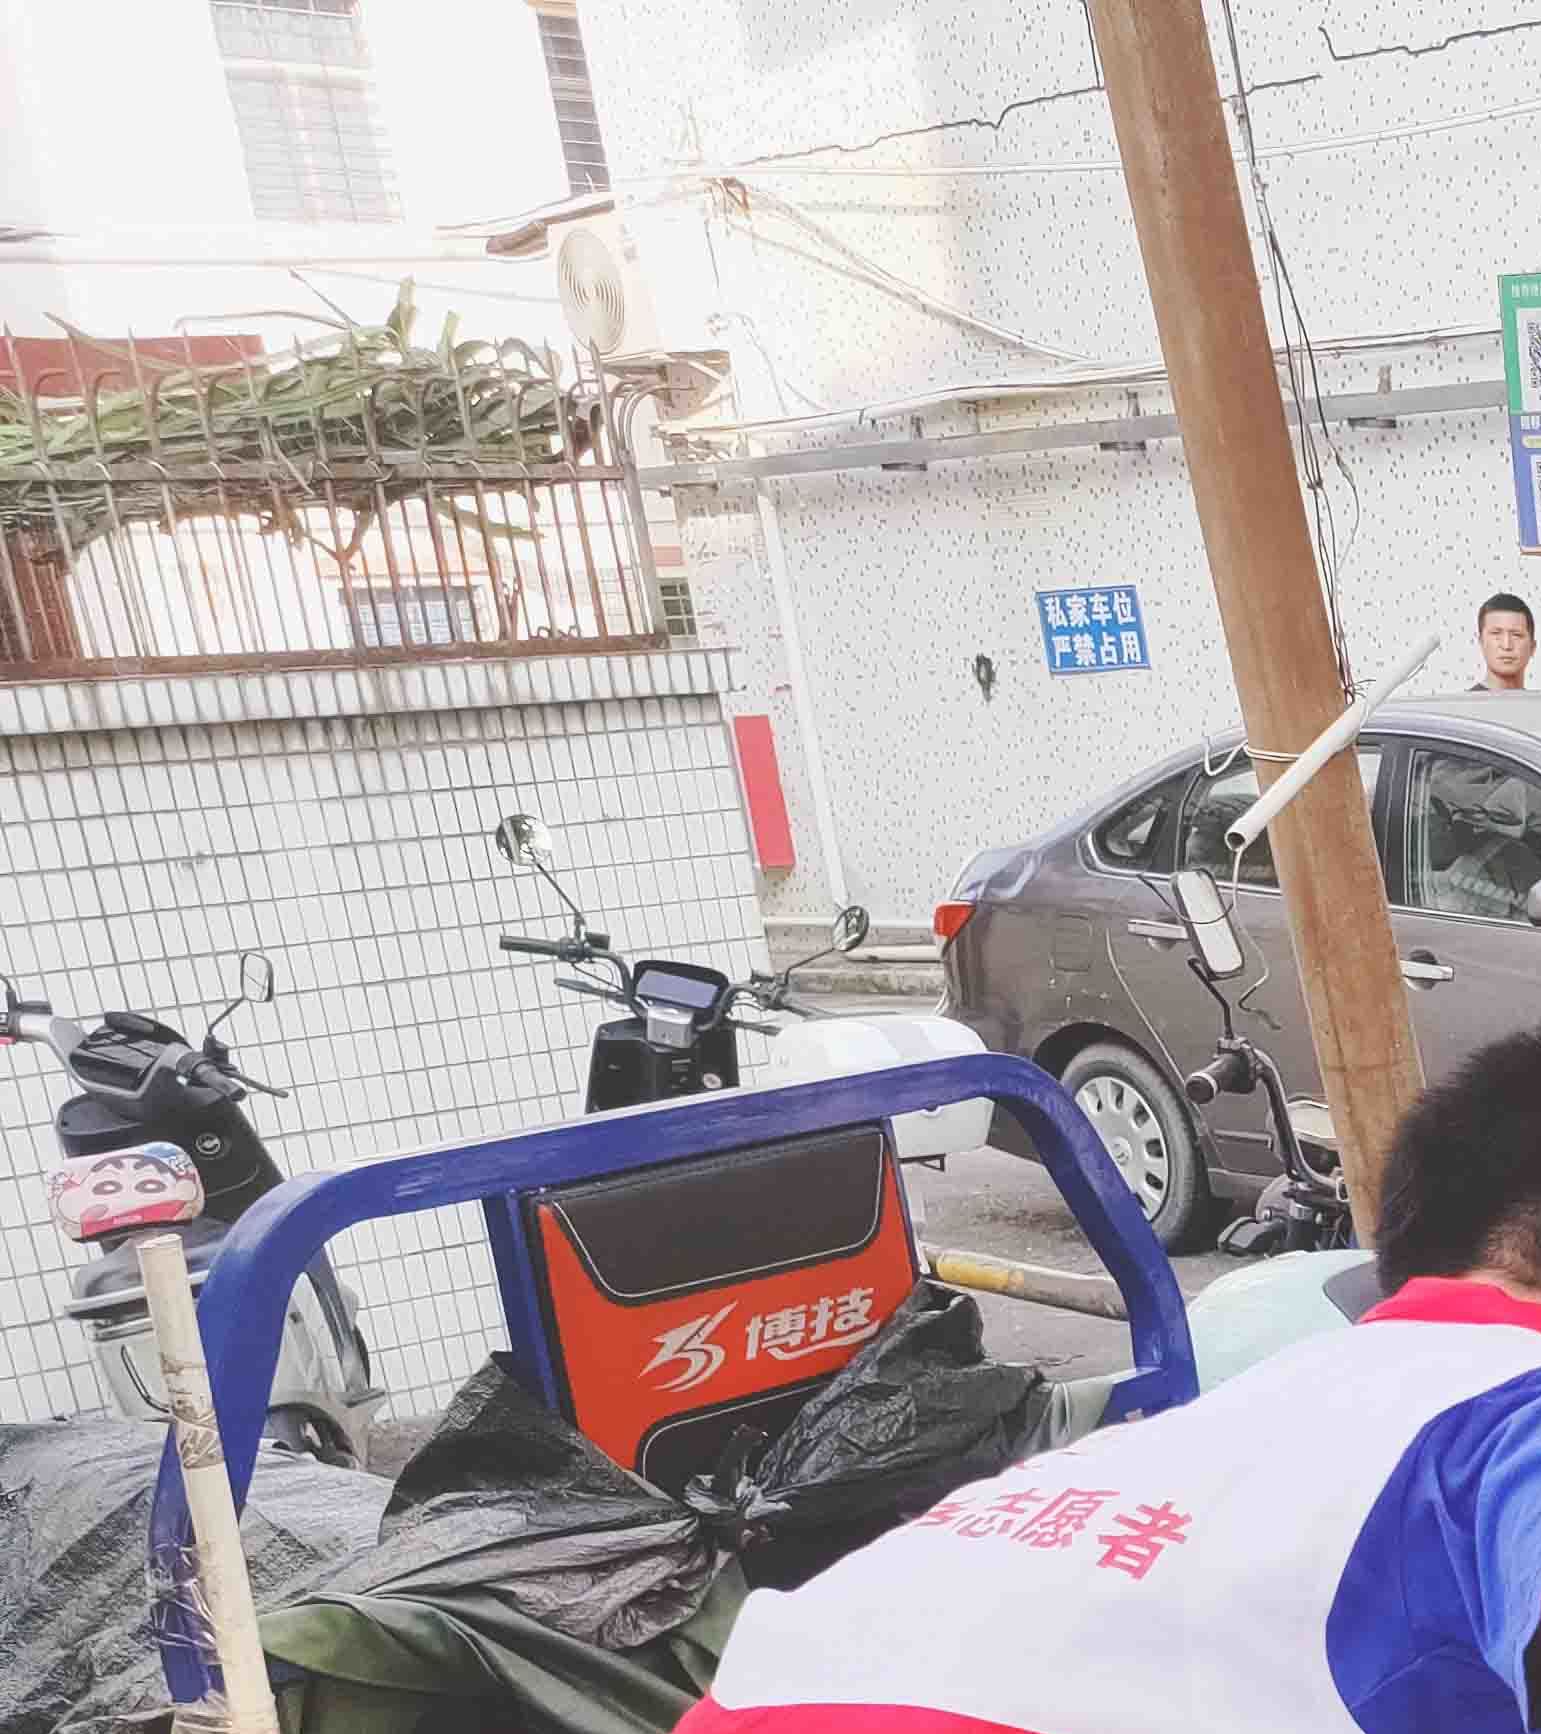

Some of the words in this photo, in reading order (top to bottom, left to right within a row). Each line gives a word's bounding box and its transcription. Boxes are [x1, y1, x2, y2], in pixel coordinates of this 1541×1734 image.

[1045, 591, 1136, 628] 私家车位
[1051, 631, 1142, 668] 严禁占用
